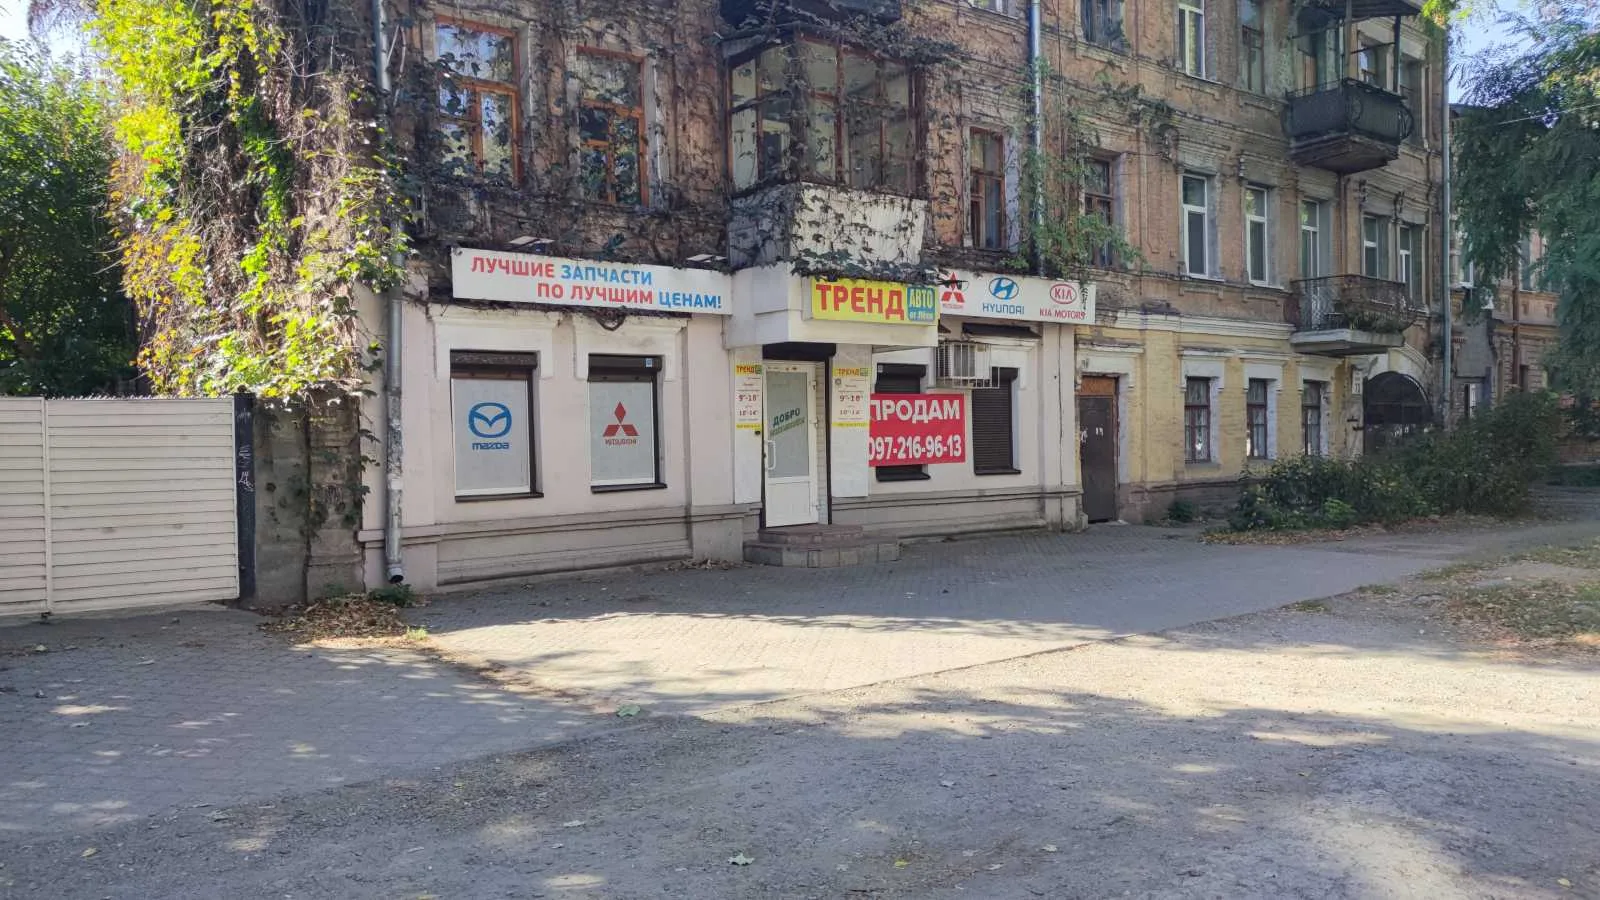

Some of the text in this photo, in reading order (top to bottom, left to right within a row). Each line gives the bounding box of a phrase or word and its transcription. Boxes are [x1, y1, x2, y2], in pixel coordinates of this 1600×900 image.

[471, 256, 652, 286] ЛУЧШИЕ ЗАПЧАСТИ
[537, 282, 722, 309] ПО ЛУЧШИМ ЦЕНАМ!
[815, 283, 905, 320] ТРЕНД
[909, 287, 934, 308] АВТО
[1054, 287, 1074, 301] KIA
[982, 302, 1025, 315] HYUNDAI
[1039, 307, 1052, 317] KIA
[772, 407, 801, 429] ДОБРО
[870, 399, 960, 424] ПРОДАМ
[472, 442, 510, 450] mazda
[868, 434, 962, 460] 097-216-96-13
